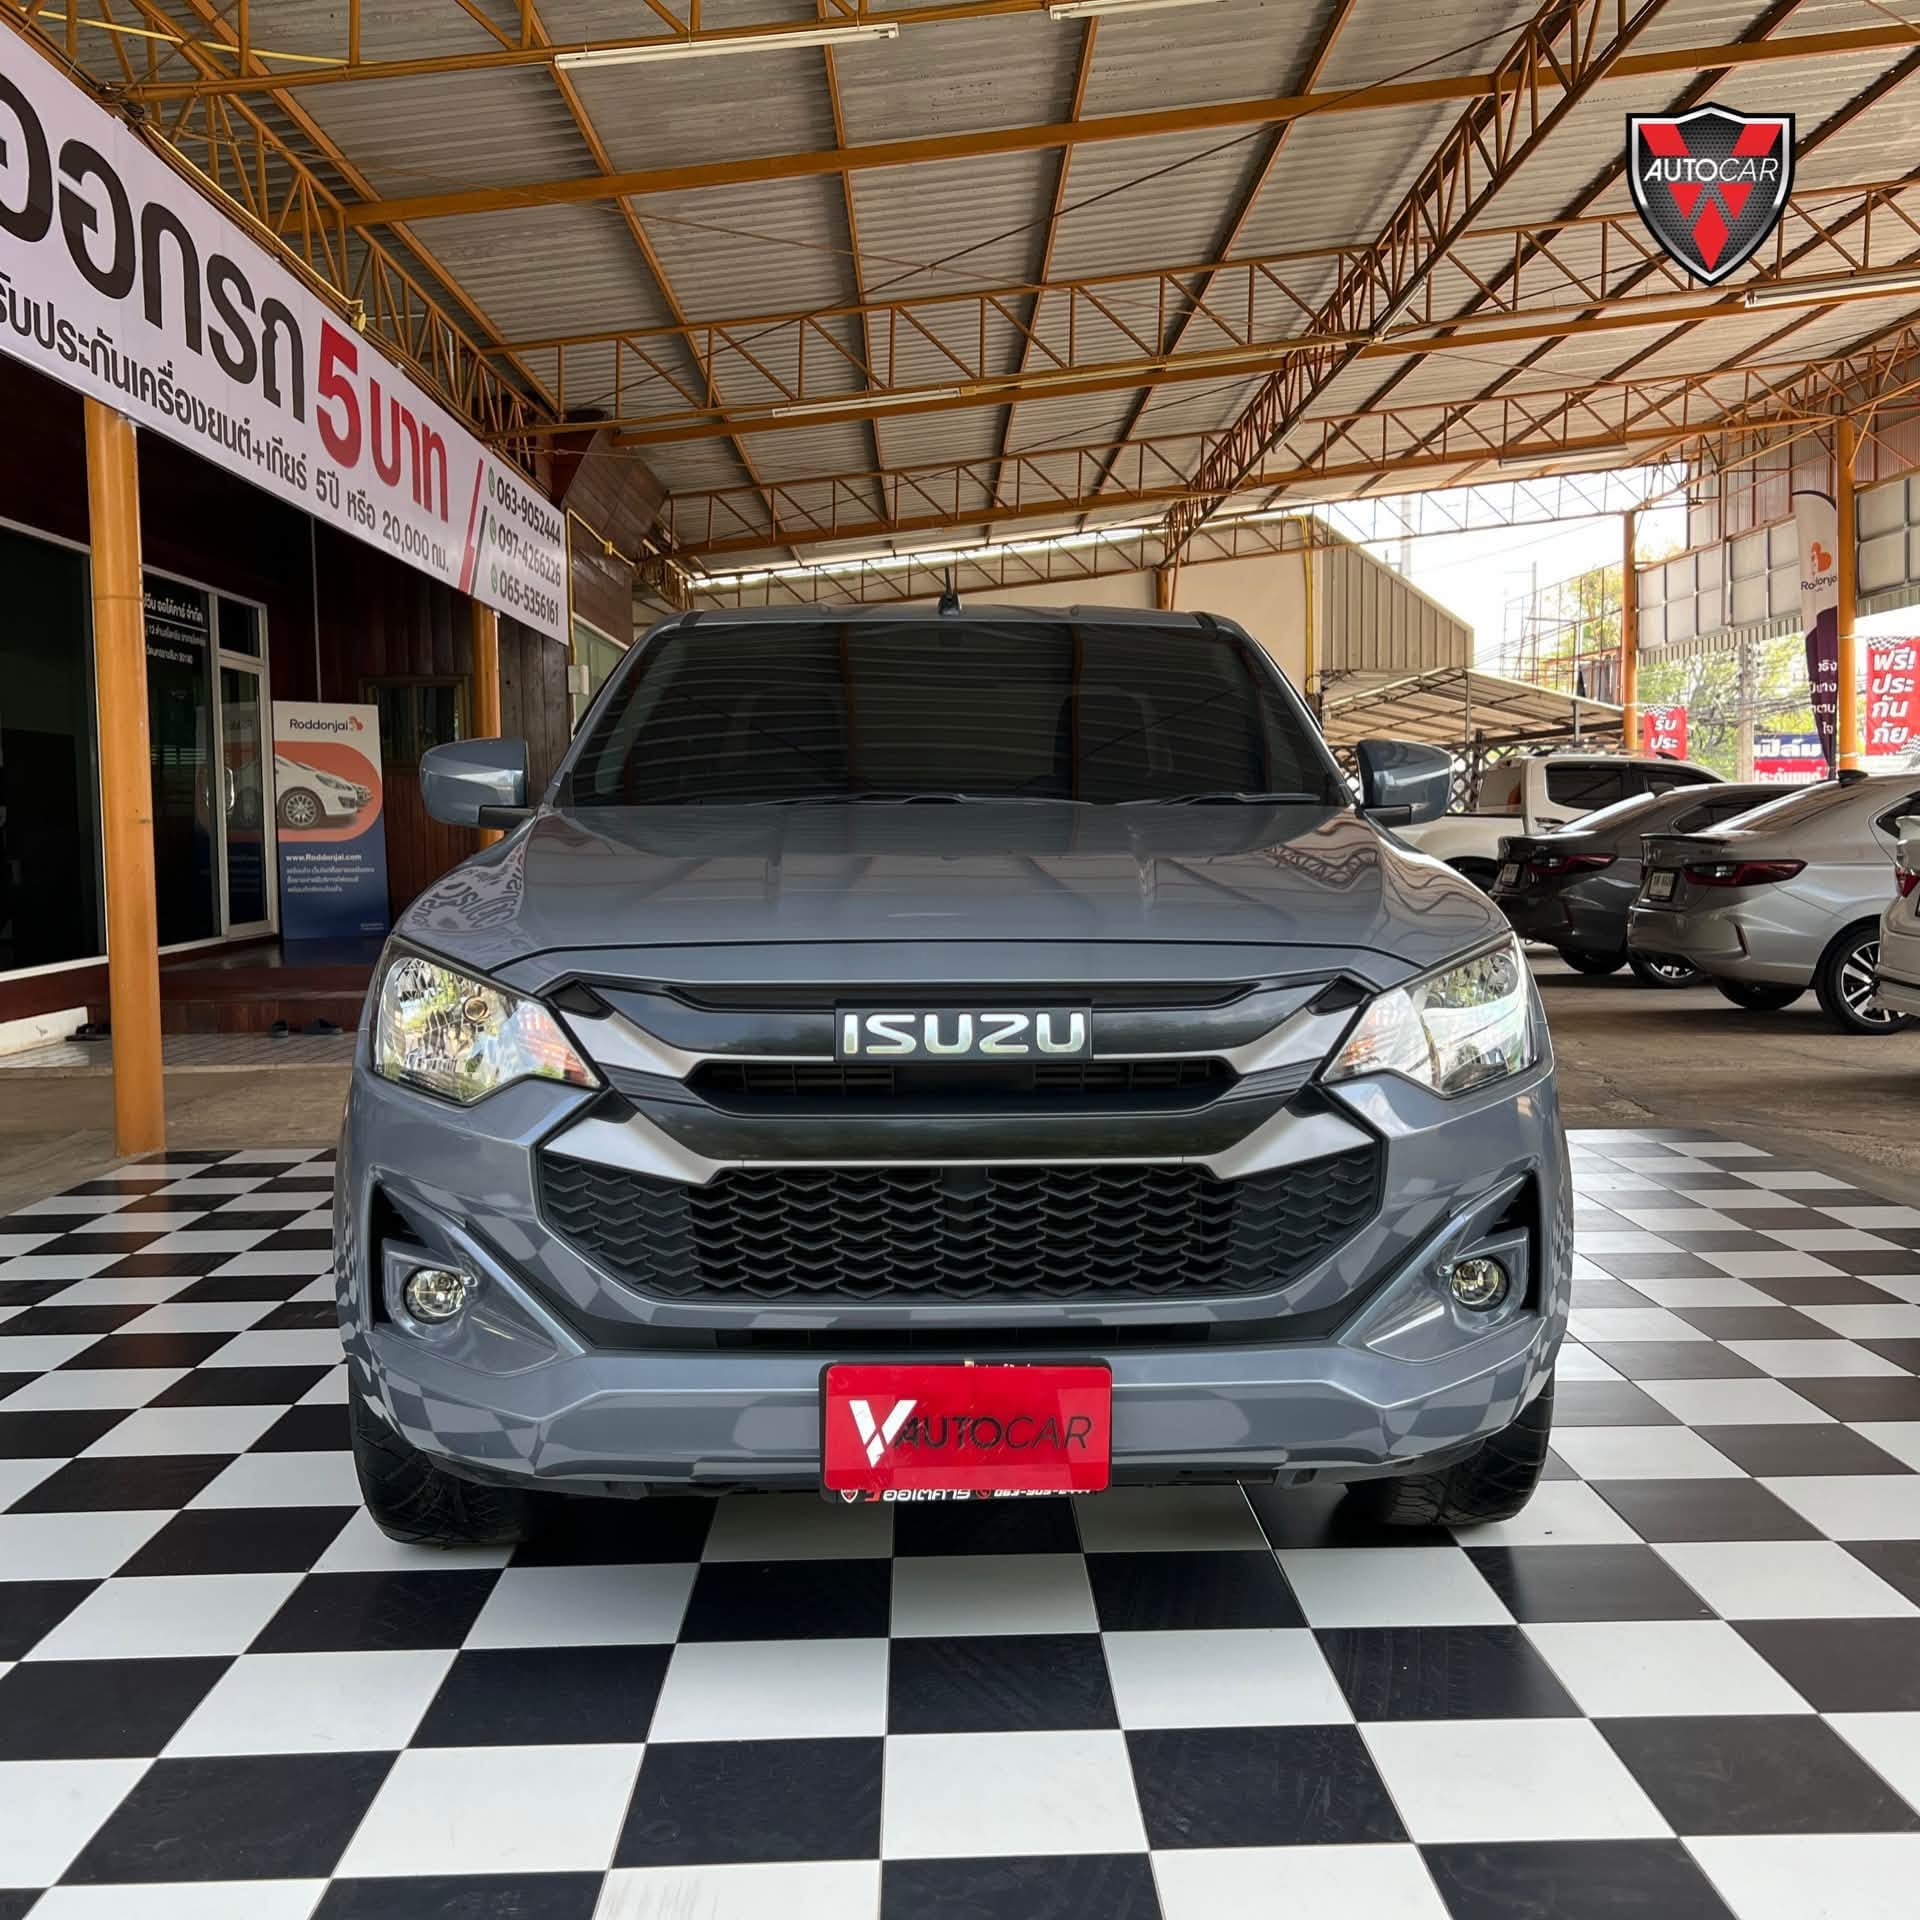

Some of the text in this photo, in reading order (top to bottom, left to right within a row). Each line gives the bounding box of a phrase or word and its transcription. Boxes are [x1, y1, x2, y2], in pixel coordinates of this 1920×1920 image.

[316, 318, 362, 469] 5
[370, 377, 449, 523] บาท
[347, 486, 376, 531] หรือ
[382, 510, 429, 561] 20,000
[497, 476, 561, 548] 063-9052444
[498, 523, 561, 587] 097-4266226
[500, 571, 559, 627] 065-5356161
[1873, 646, 1917, 671] ฟรี!
[1872, 674, 1915, 694] ประ
[1871, 695, 1909, 718] กัน
[289, 719, 349, 733] Roddonjai
[1650, 734, 1679, 750] ประ
[1871, 722, 1909, 744] ภัย
[843, 1012, 1086, 1055] ISUZU
[893, 1415, 1093, 1449] AUTOCAR
